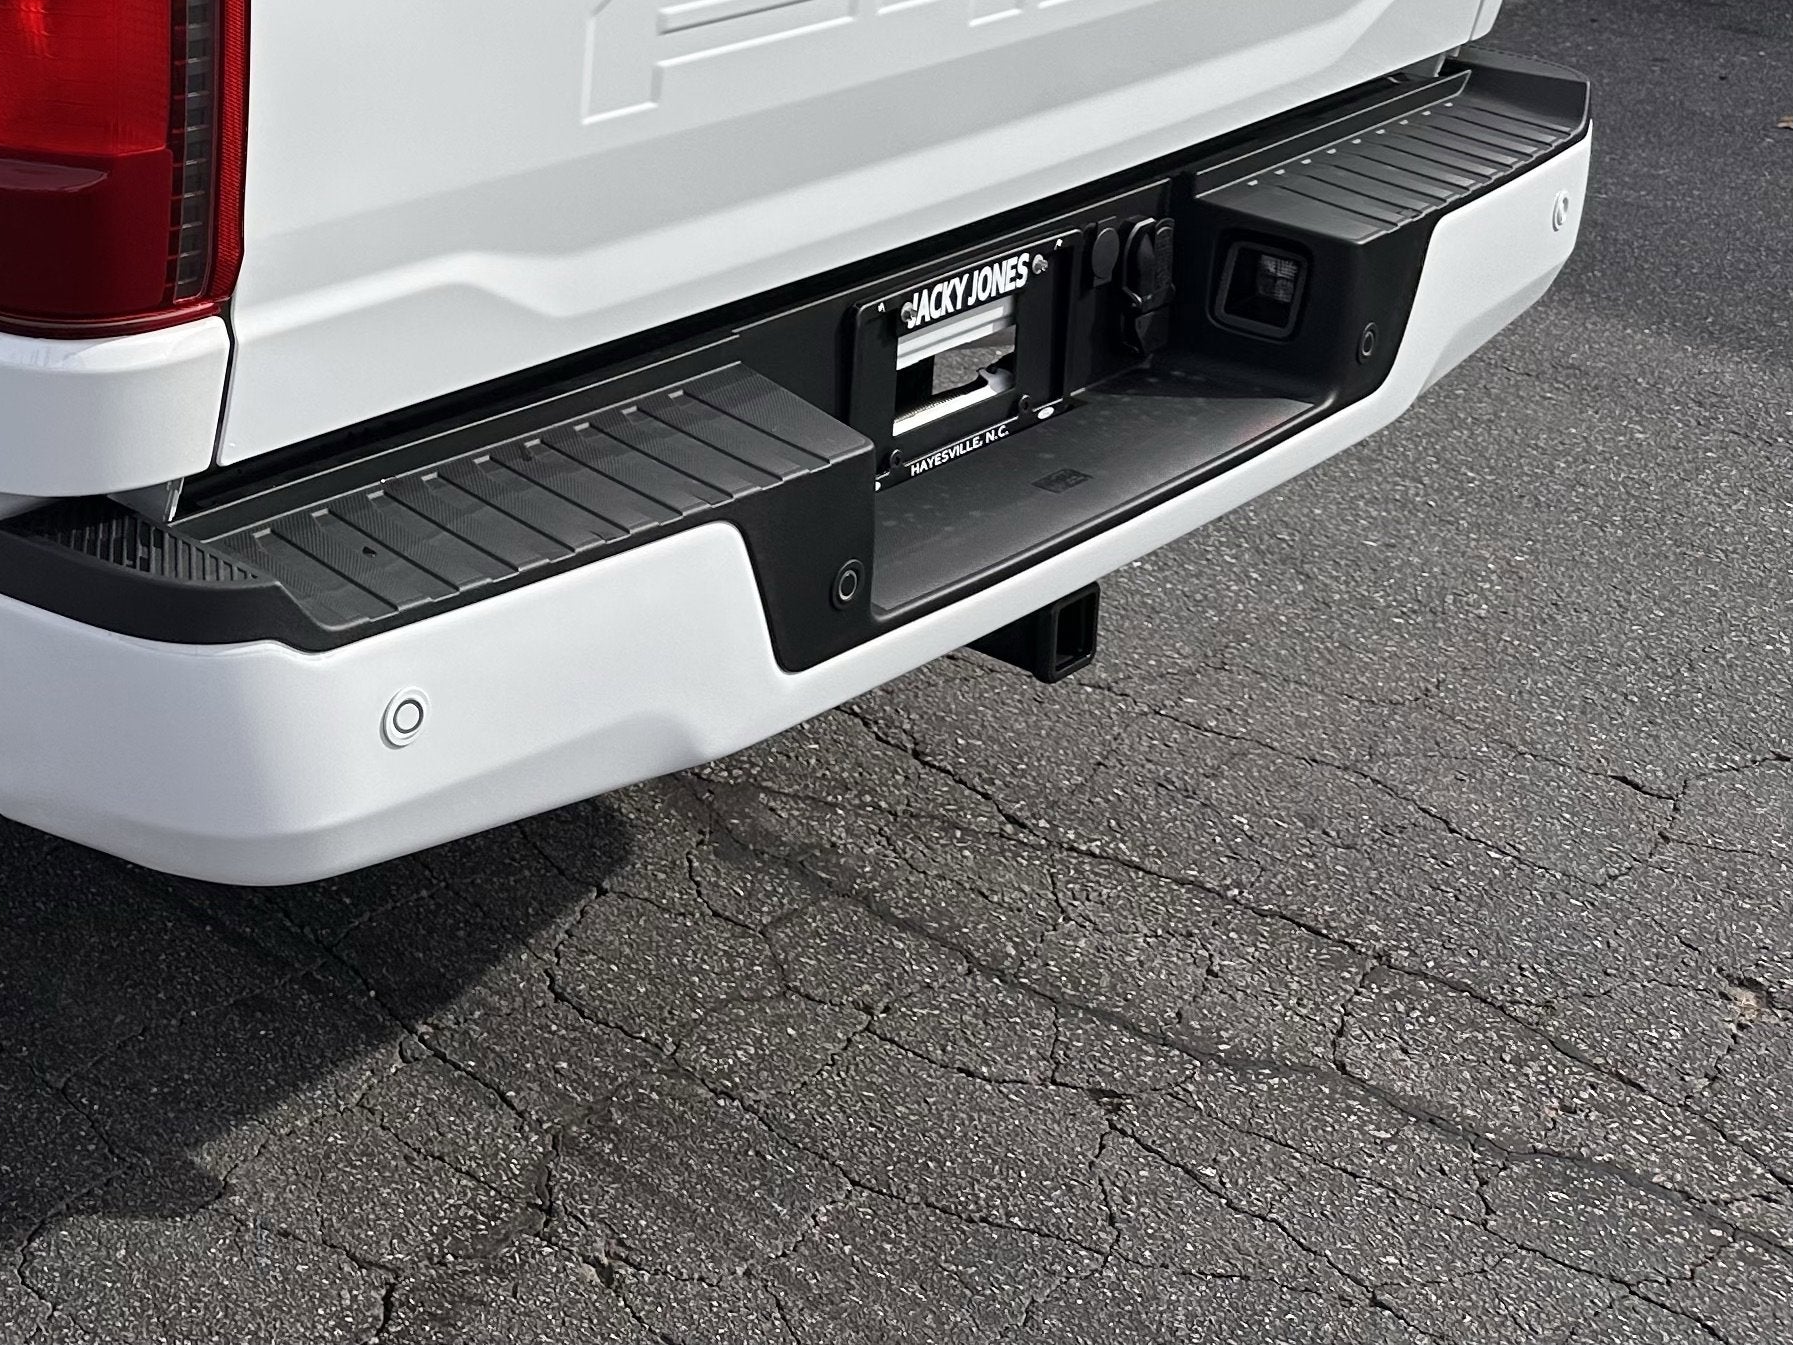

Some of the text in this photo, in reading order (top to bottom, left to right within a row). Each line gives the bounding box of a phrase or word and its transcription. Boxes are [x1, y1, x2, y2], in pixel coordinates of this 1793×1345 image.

[906, 252, 1030, 330] JACKY JONES
[910, 424, 1010, 477] HAYESVILLE, N.C.
